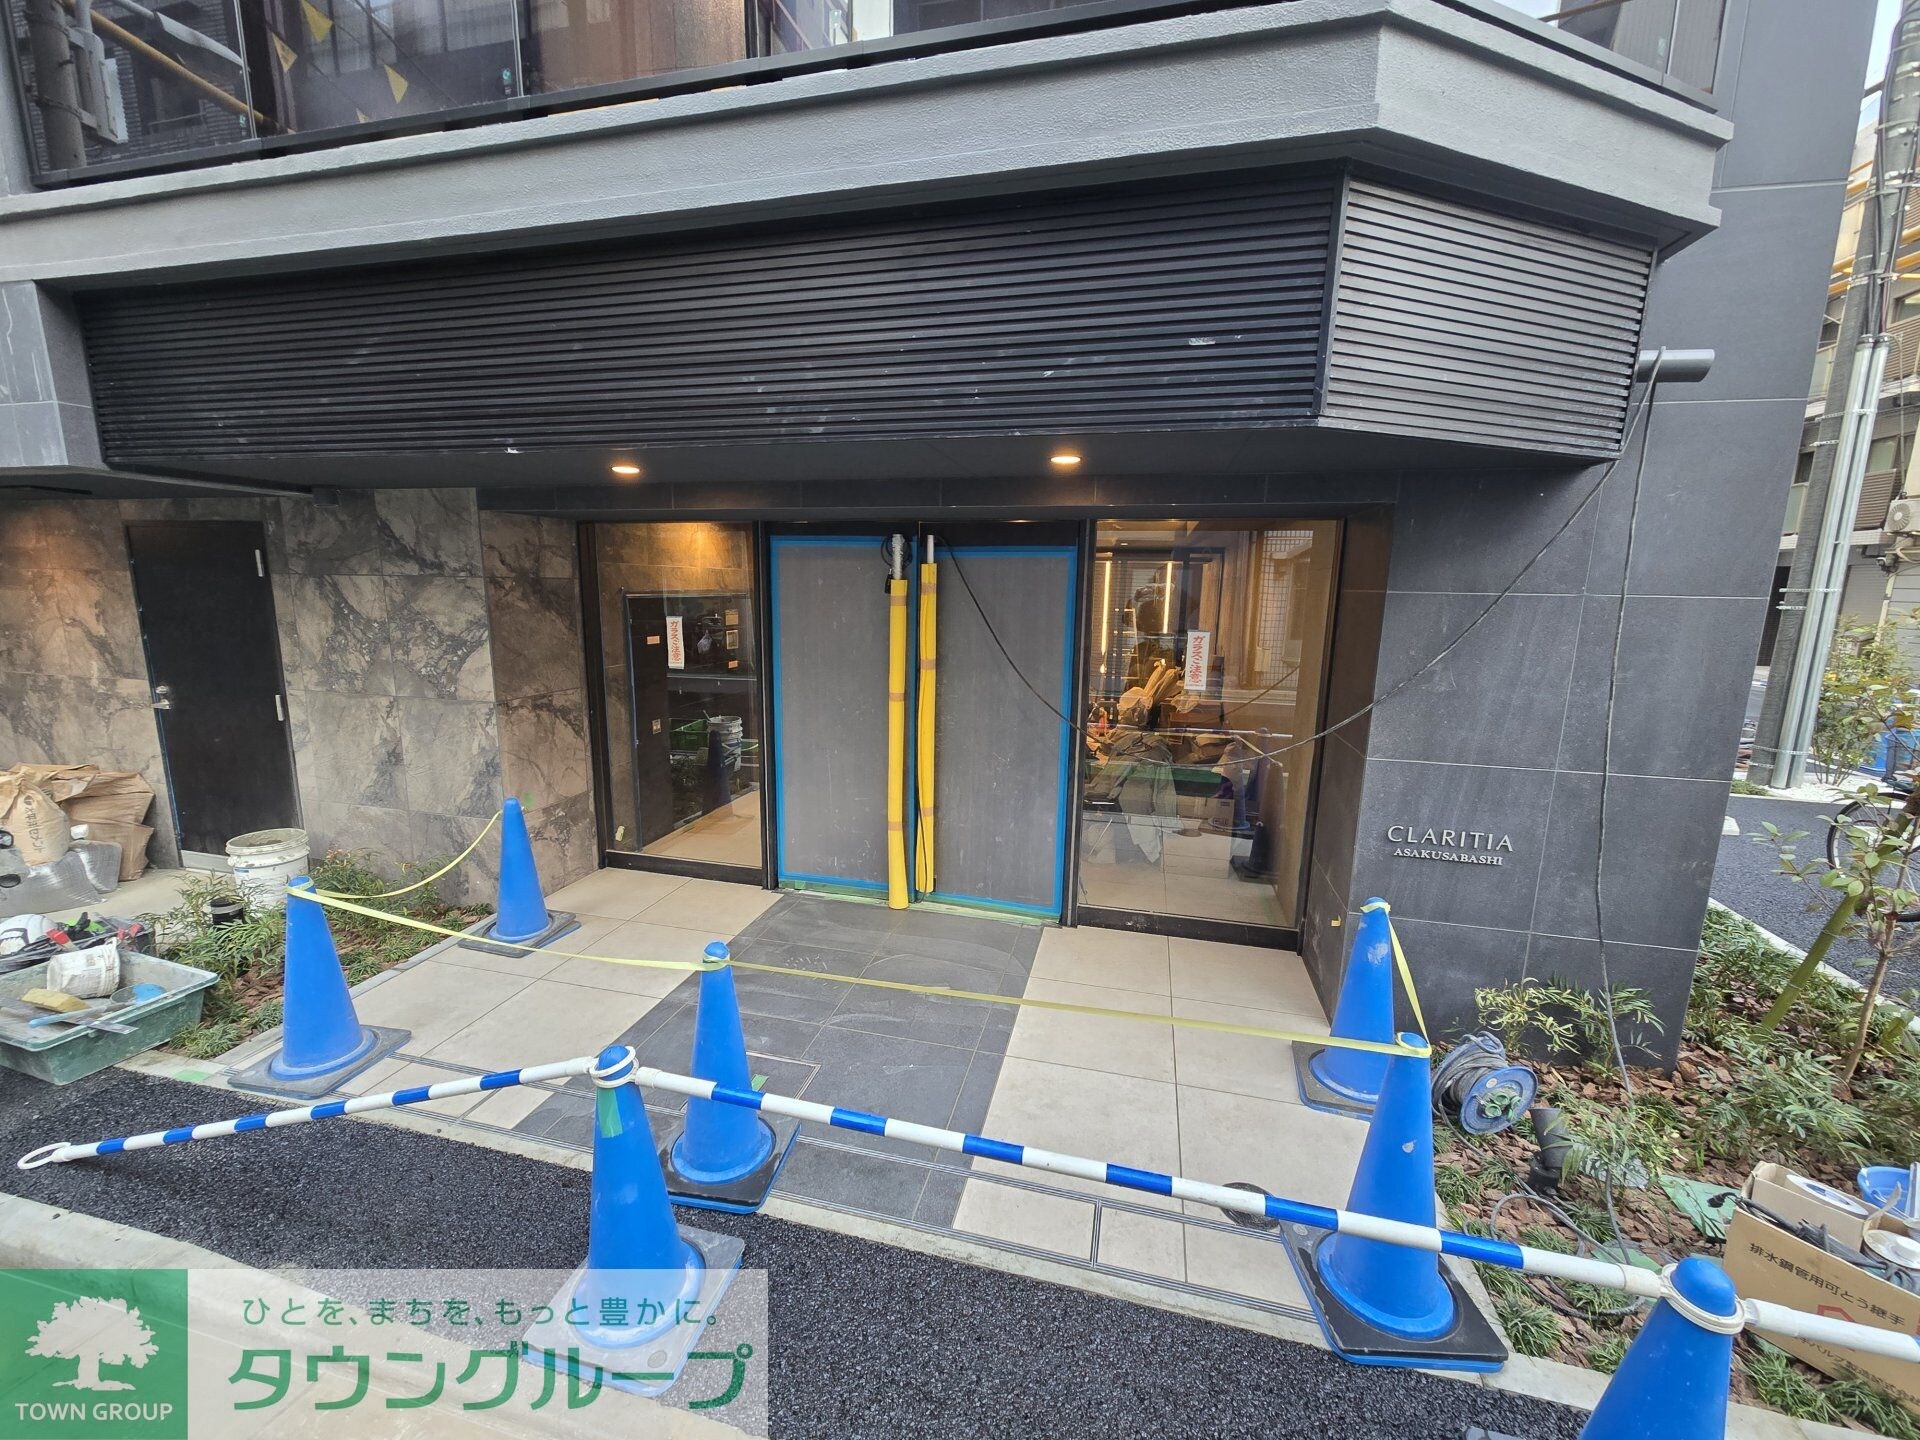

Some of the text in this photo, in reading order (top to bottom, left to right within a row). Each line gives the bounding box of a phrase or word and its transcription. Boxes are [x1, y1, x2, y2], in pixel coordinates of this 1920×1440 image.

[670, 620, 682, 662] ガラスご注意
[1189, 635, 1205, 683] ガラスご注意
[1387, 825, 1513, 851] CLARITIA
[1394, 848, 1503, 865] ASAKUSABASHI
[1750, 1243, 1905, 1326] 排水鋼管用可とう継手
